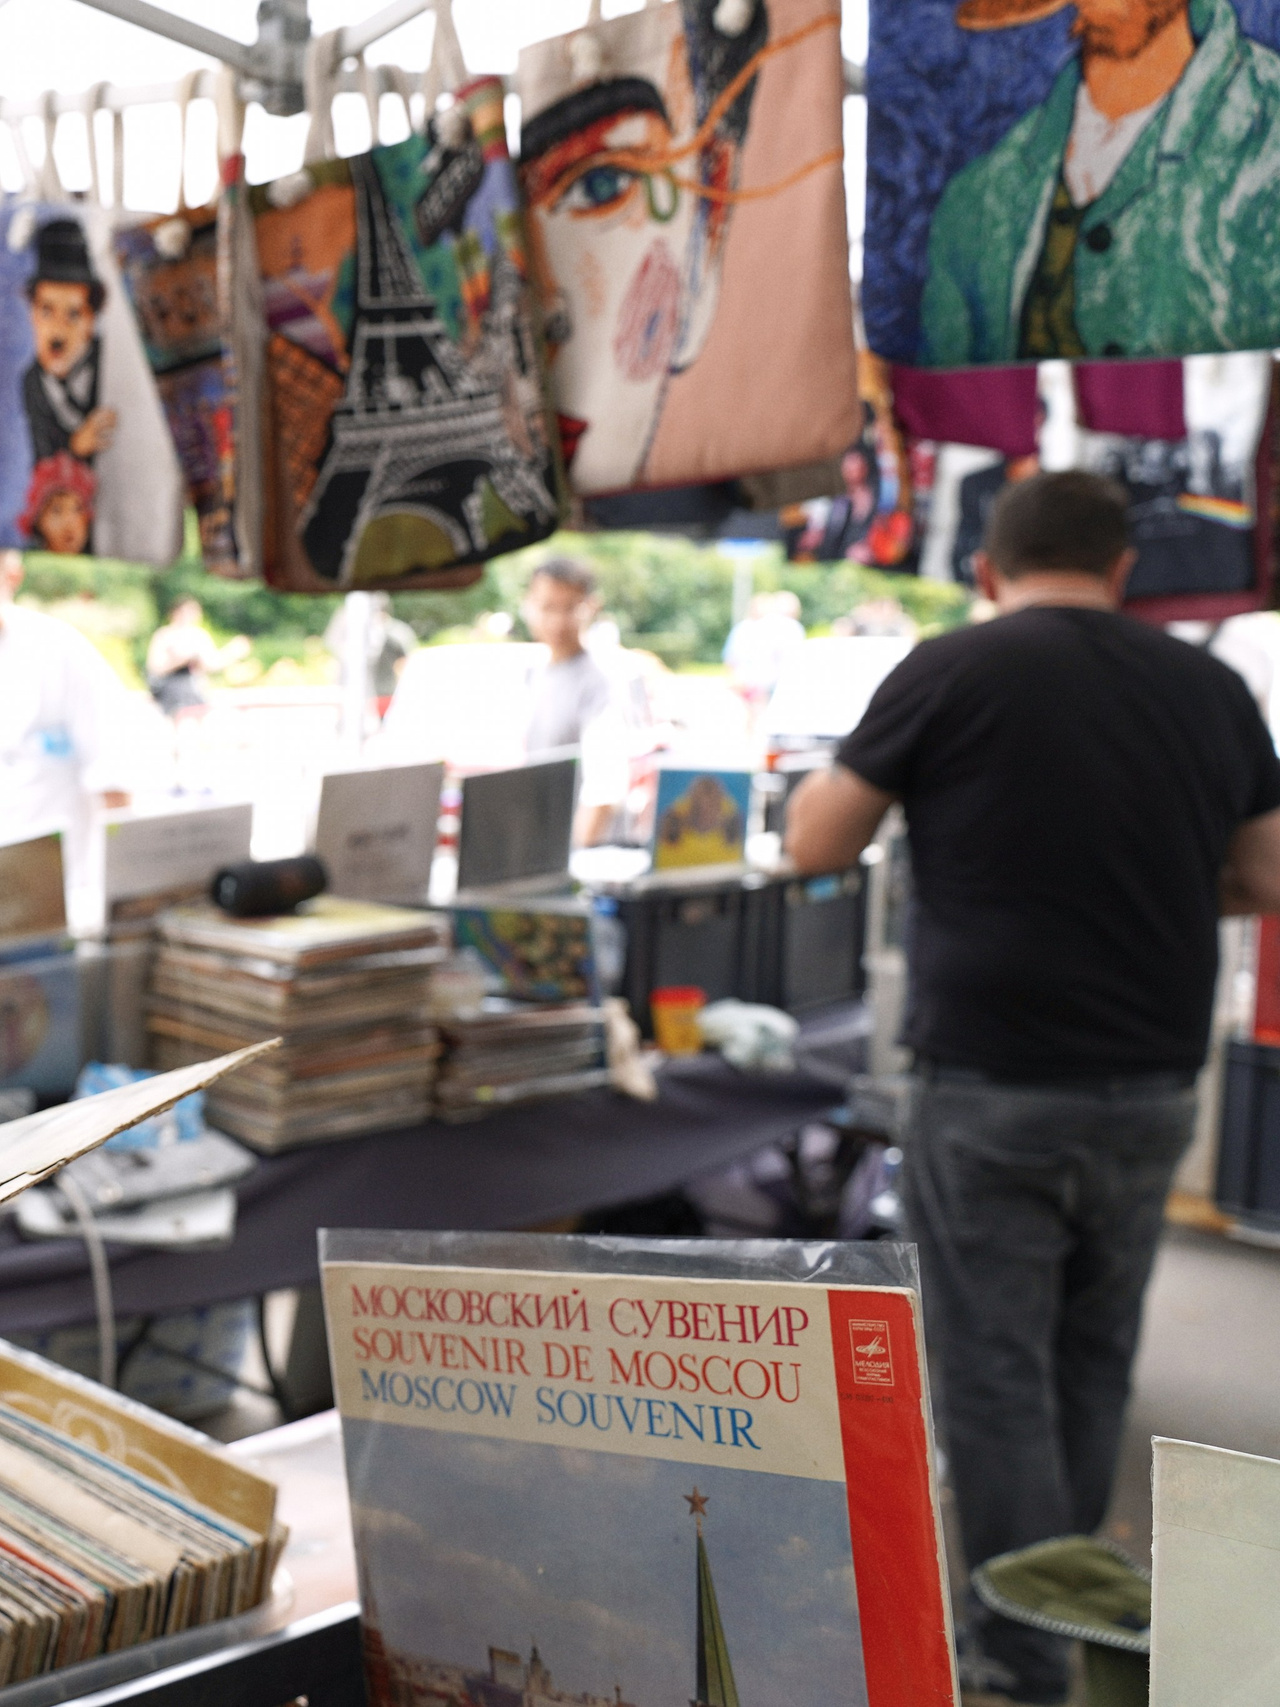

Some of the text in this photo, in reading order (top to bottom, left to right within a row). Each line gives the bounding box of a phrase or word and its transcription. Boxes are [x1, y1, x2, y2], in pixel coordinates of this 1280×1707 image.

[351, 1284, 809, 1347] МОСКОВСКИЙ СУВЕНИР
[352, 1326, 802, 1403] SOUVENIR DE MOSCOU
[359, 1368, 762, 1450] MOSCOW SOUVENIR
